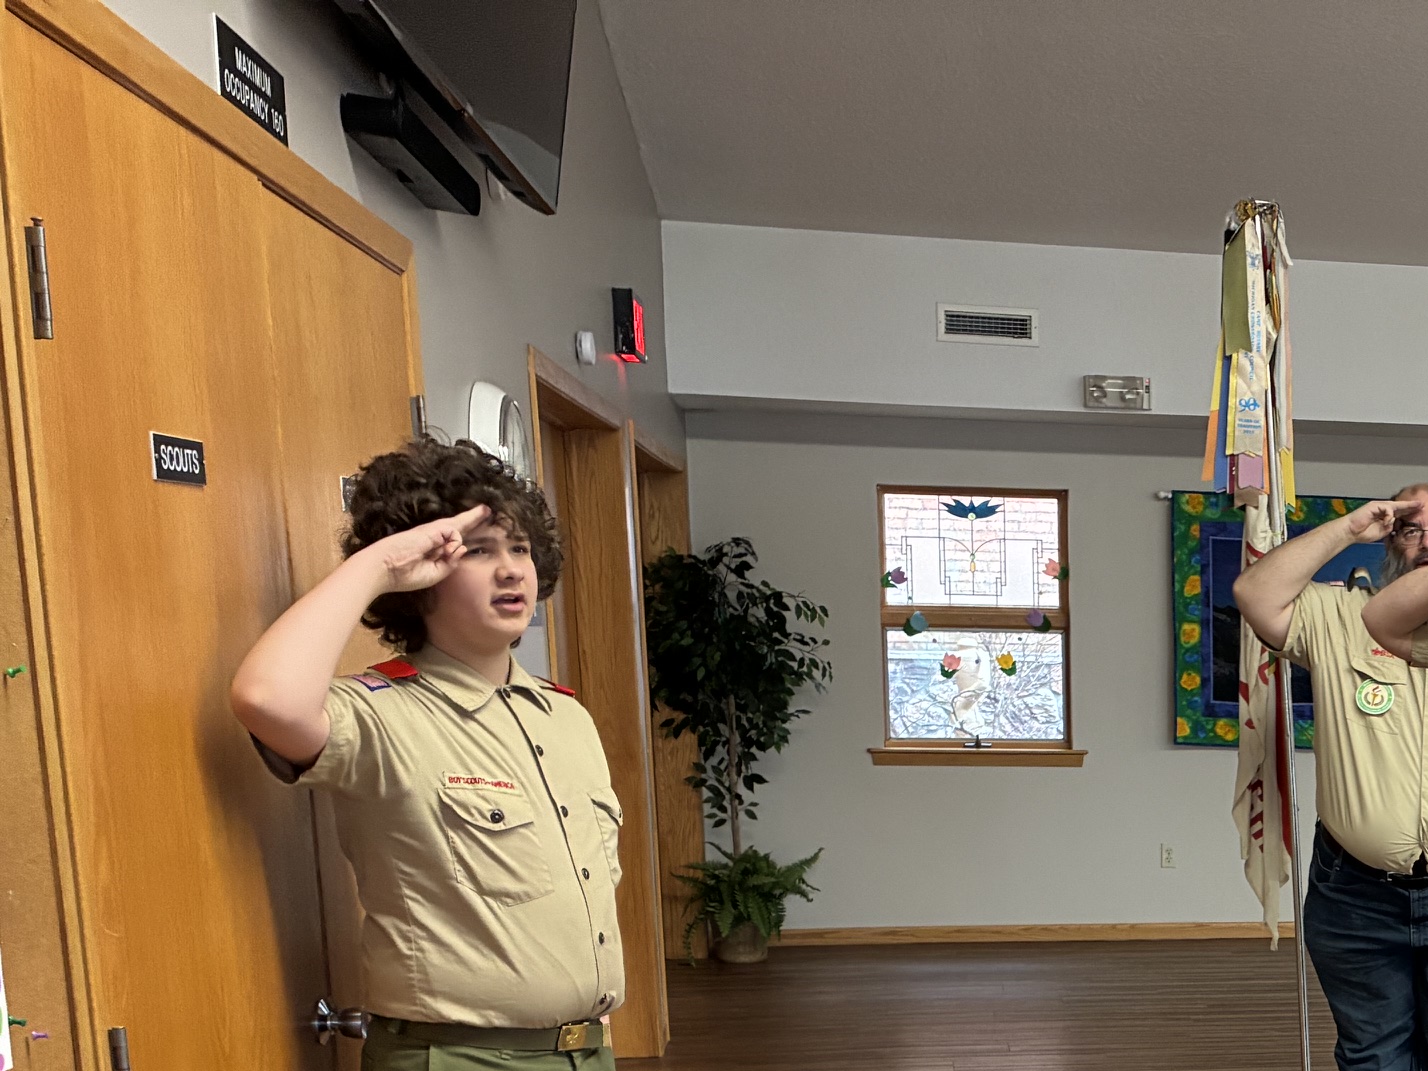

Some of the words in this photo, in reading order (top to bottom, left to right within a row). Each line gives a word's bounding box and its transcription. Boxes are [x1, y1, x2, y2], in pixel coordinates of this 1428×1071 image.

[224, 68, 269, 123] OCCUPANCY
[234, 46, 272, 98] MAXIMUM
[160, 444, 200, 474] SCOUTS
